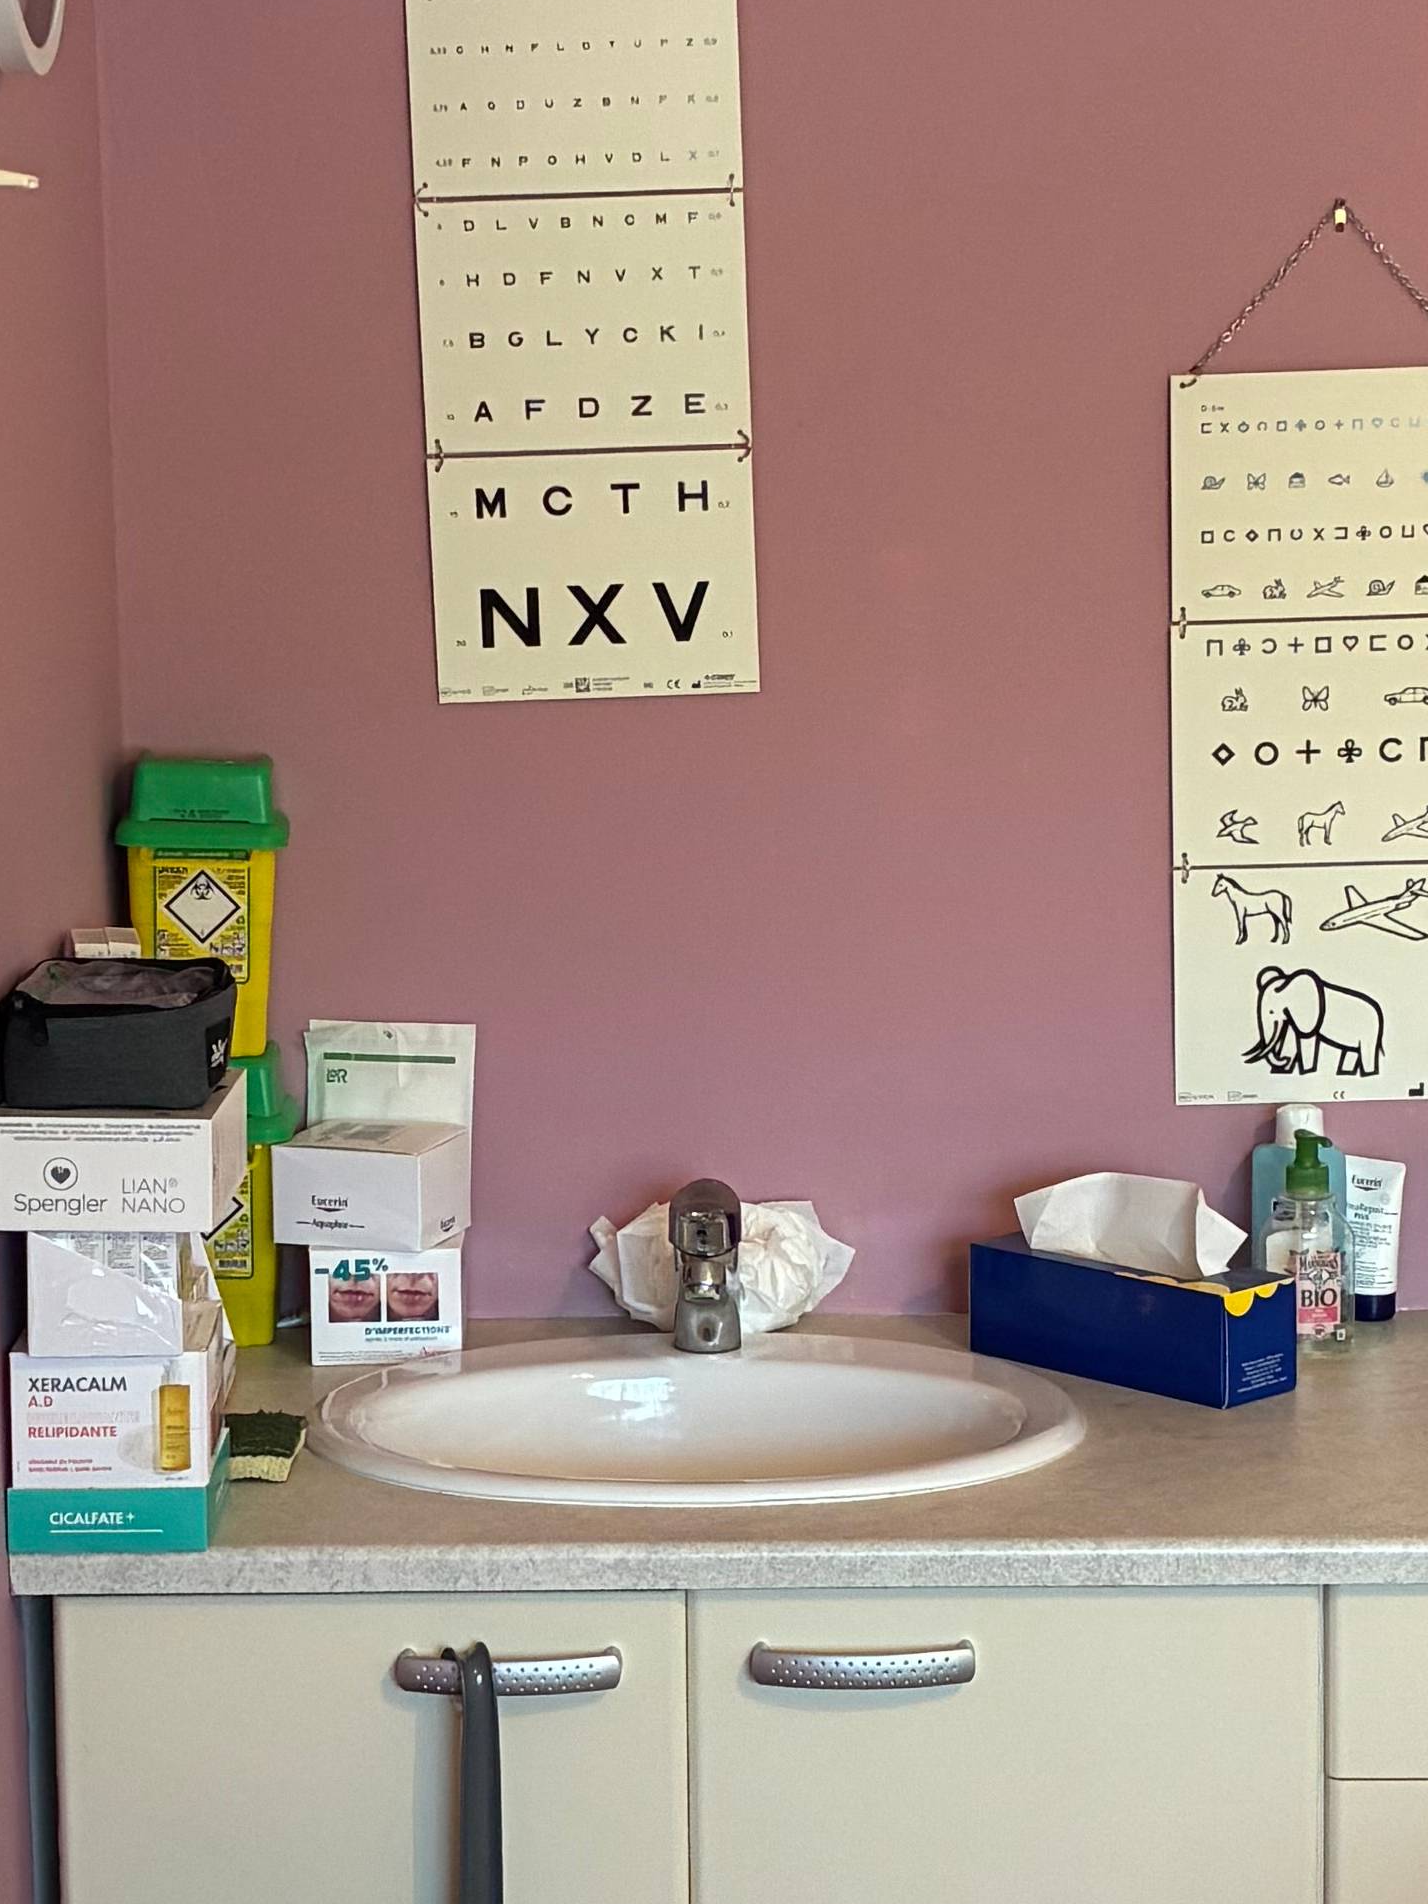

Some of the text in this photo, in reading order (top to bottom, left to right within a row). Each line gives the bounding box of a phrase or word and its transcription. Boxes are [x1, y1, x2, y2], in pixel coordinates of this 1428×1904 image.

[544, 98, 554, 109] U
[572, 97, 583, 108] Z
[491, 157, 500, 167] N
[519, 156, 528, 166] P
[548, 155, 557, 165] O
[576, 154, 585, 164] H
[605, 153, 613, 163] V
[660, 151, 671, 162] L
[464, 220, 474, 231] D
[496, 220, 506, 230] L
[529, 218, 538, 229] V
[561, 217, 570, 228] B
[593, 216, 603, 226] N
[656, 213, 666, 224] M
[688, 212, 698, 223] F
[467, 274, 479, 287] H
[503, 273, 515, 285] D
[540, 272, 552, 284] F
[578, 270, 590, 283] N
[615, 269, 625, 281] V
[652, 267, 662, 280] X
[689, 266, 700, 279] T
[469, 333, 485, 348] B
[508, 332, 523, 347] G
[547, 330, 562, 346] L
[585, 328, 599, 344] Y
[623, 328, 637, 343] C
[660, 326, 675, 342] K
[699, 325, 703, 340] I
[475, 401, 493, 422] A
[525, 400, 545, 420] F
[579, 398, 599, 418] D
[631, 395, 652, 416] Z
[685, 394, 705, 414] E
[475, 488, 506, 519] M
[543, 486, 572, 516] C
[611, 483, 640, 514] T
[678, 480, 708, 512] H
[480, 587, 541, 648] N
[567, 584, 626, 645] X
[652, 581, 709, 641] V
[14, 1194, 108, 1216] Spengler
[122, 1198, 186, 1214] NANO
[314, 1258, 389, 1281] -45%
[1301, 1288, 1337, 1307] BIO
[28, 1376, 127, 1393] XERACALM
[28, 1396, 53, 1408] A.D
[28, 1426, 118, 1439] RELIPIDANTE
